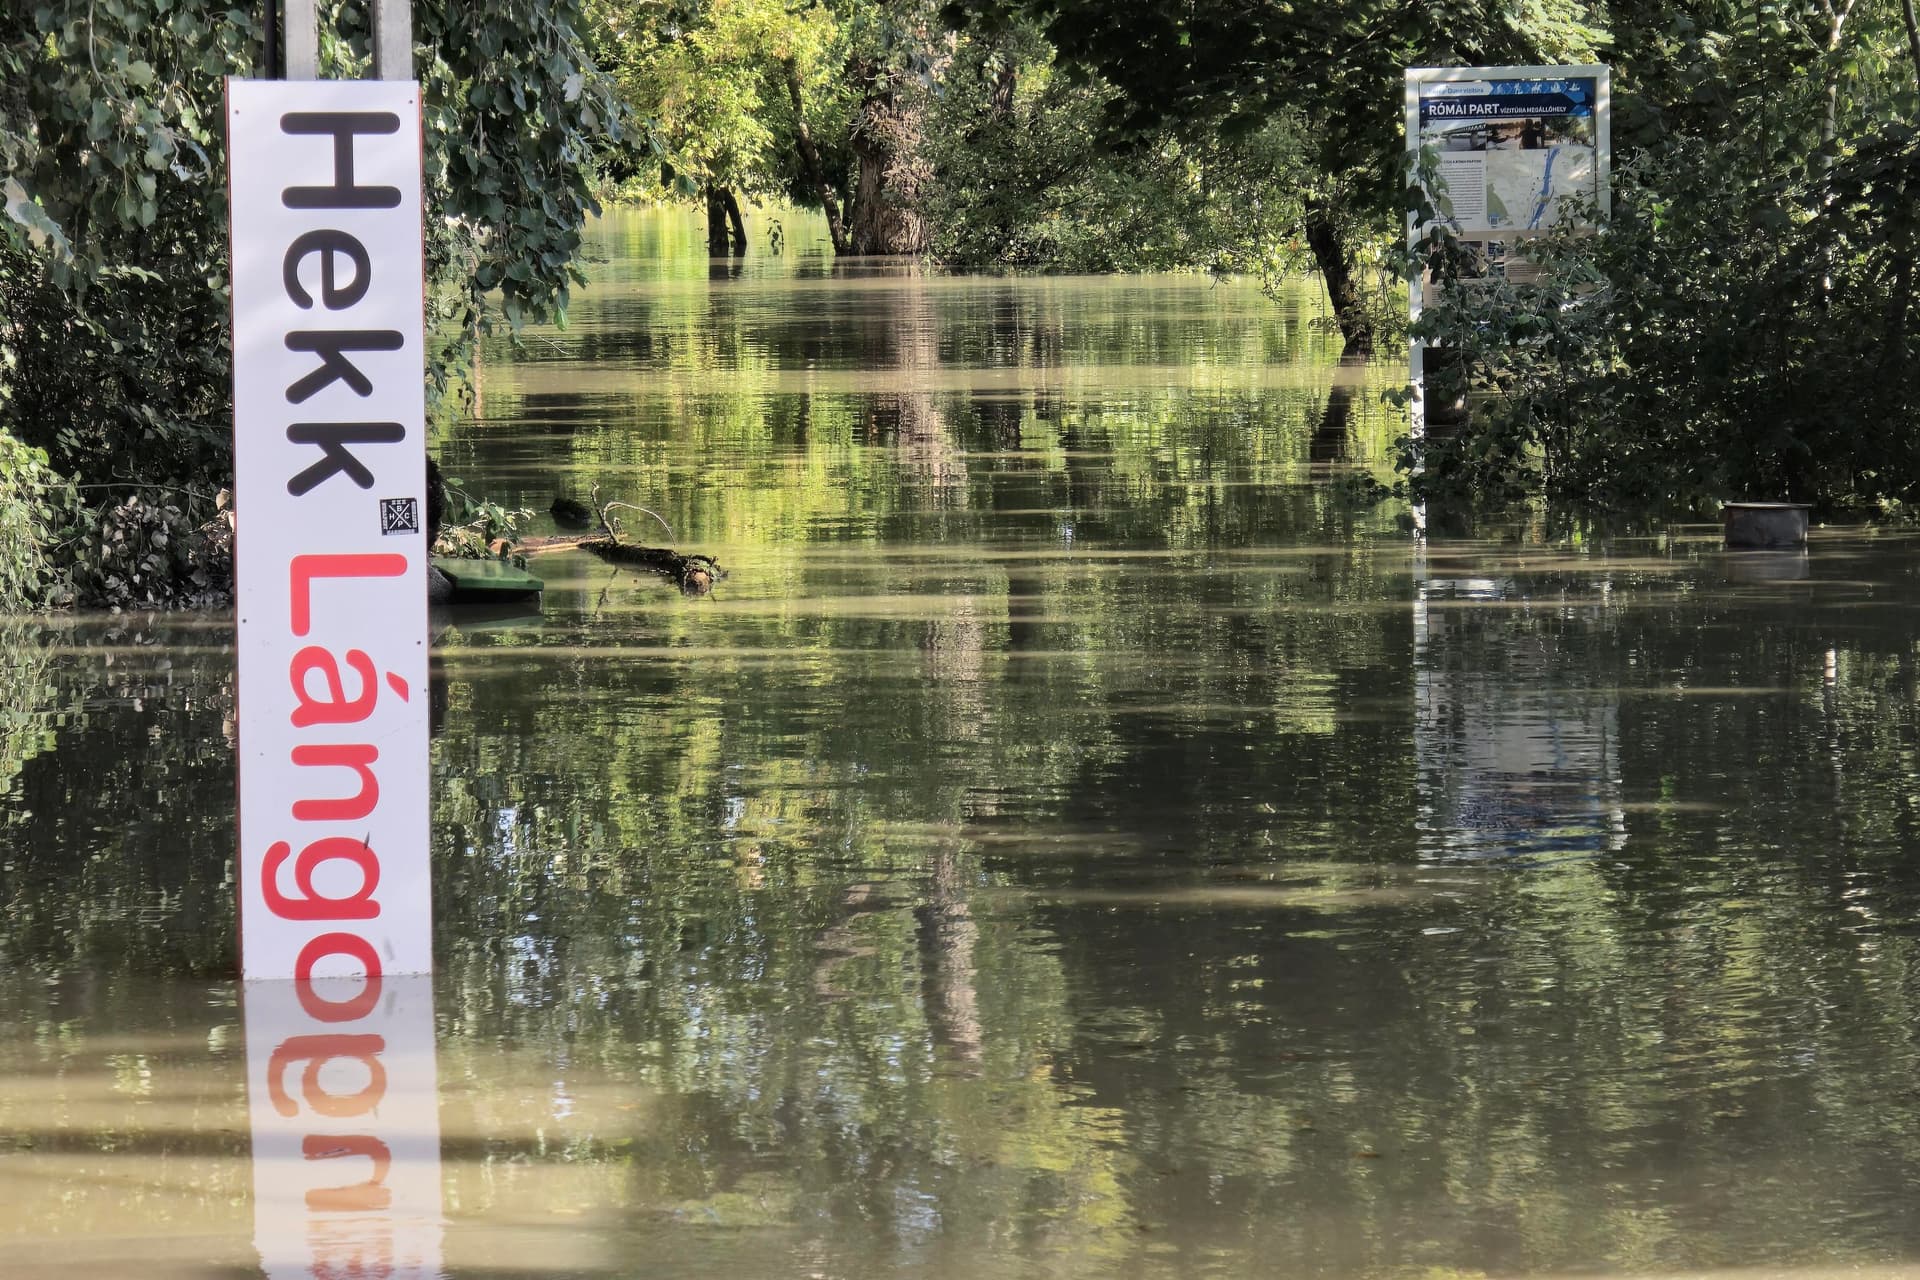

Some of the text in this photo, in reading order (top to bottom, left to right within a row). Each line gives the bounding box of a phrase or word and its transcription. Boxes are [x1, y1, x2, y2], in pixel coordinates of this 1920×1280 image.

[1429, 102, 1467, 116] RÓMAI
[1469, 103, 1500, 115] PART
[280, 112, 406, 497] Hekk
